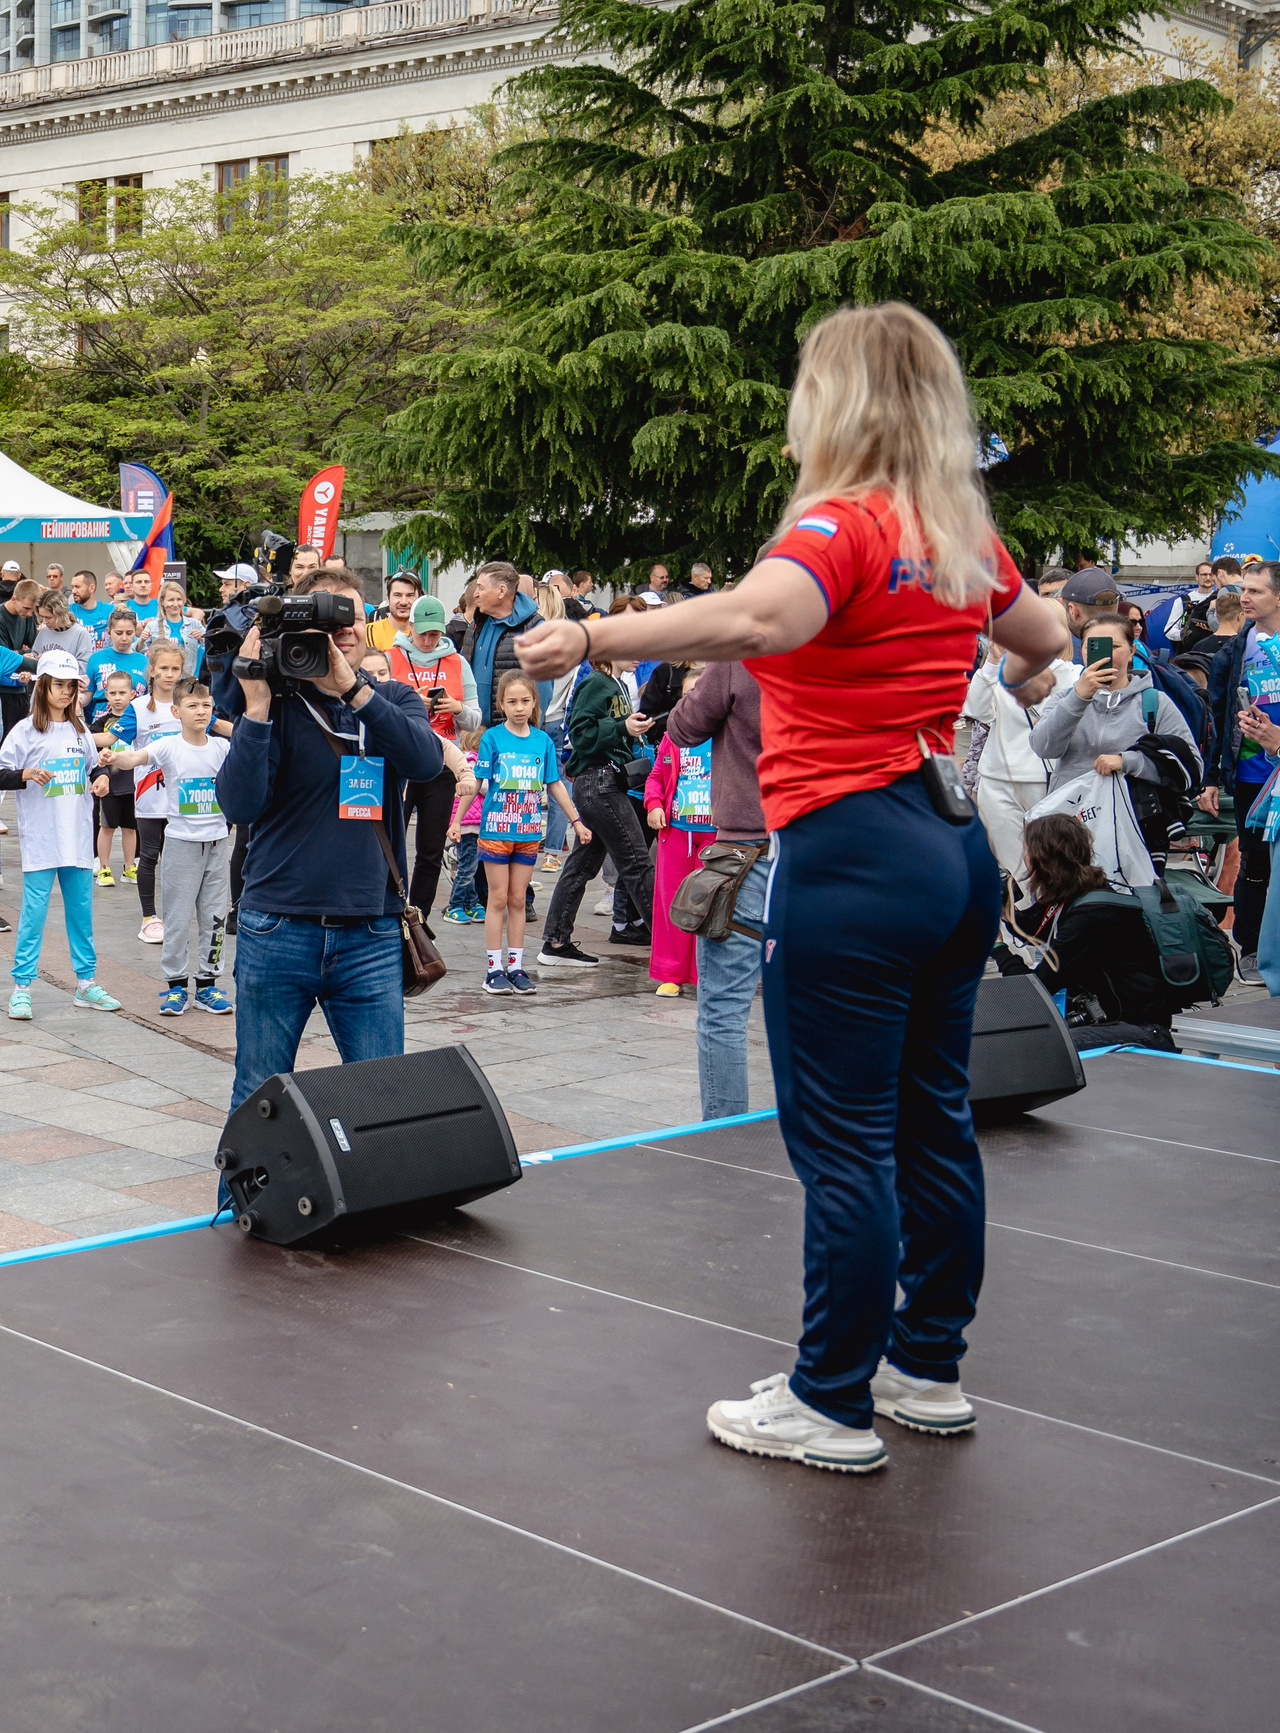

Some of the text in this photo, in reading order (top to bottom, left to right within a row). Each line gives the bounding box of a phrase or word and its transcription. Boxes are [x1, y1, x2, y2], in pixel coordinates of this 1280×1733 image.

[41, 519, 110, 539] ТЕЙПИРОВАНИЕ
[98, 663, 117, 674] 2024
[407, 671, 447, 683] СУДЬЯ
[54, 769, 80, 785] 10207
[511, 765, 537, 779] 10148
[493, 792, 520, 803] #ЗАБЕГ
[687, 791, 711, 804] 1014
[347, 807, 372, 818] ПРЕССА
[487, 811, 523, 823] #ЛЮБОВЬ
[485, 822, 510, 833] #ЗАБЕГ
[332, 1121, 348, 1148] FBT
